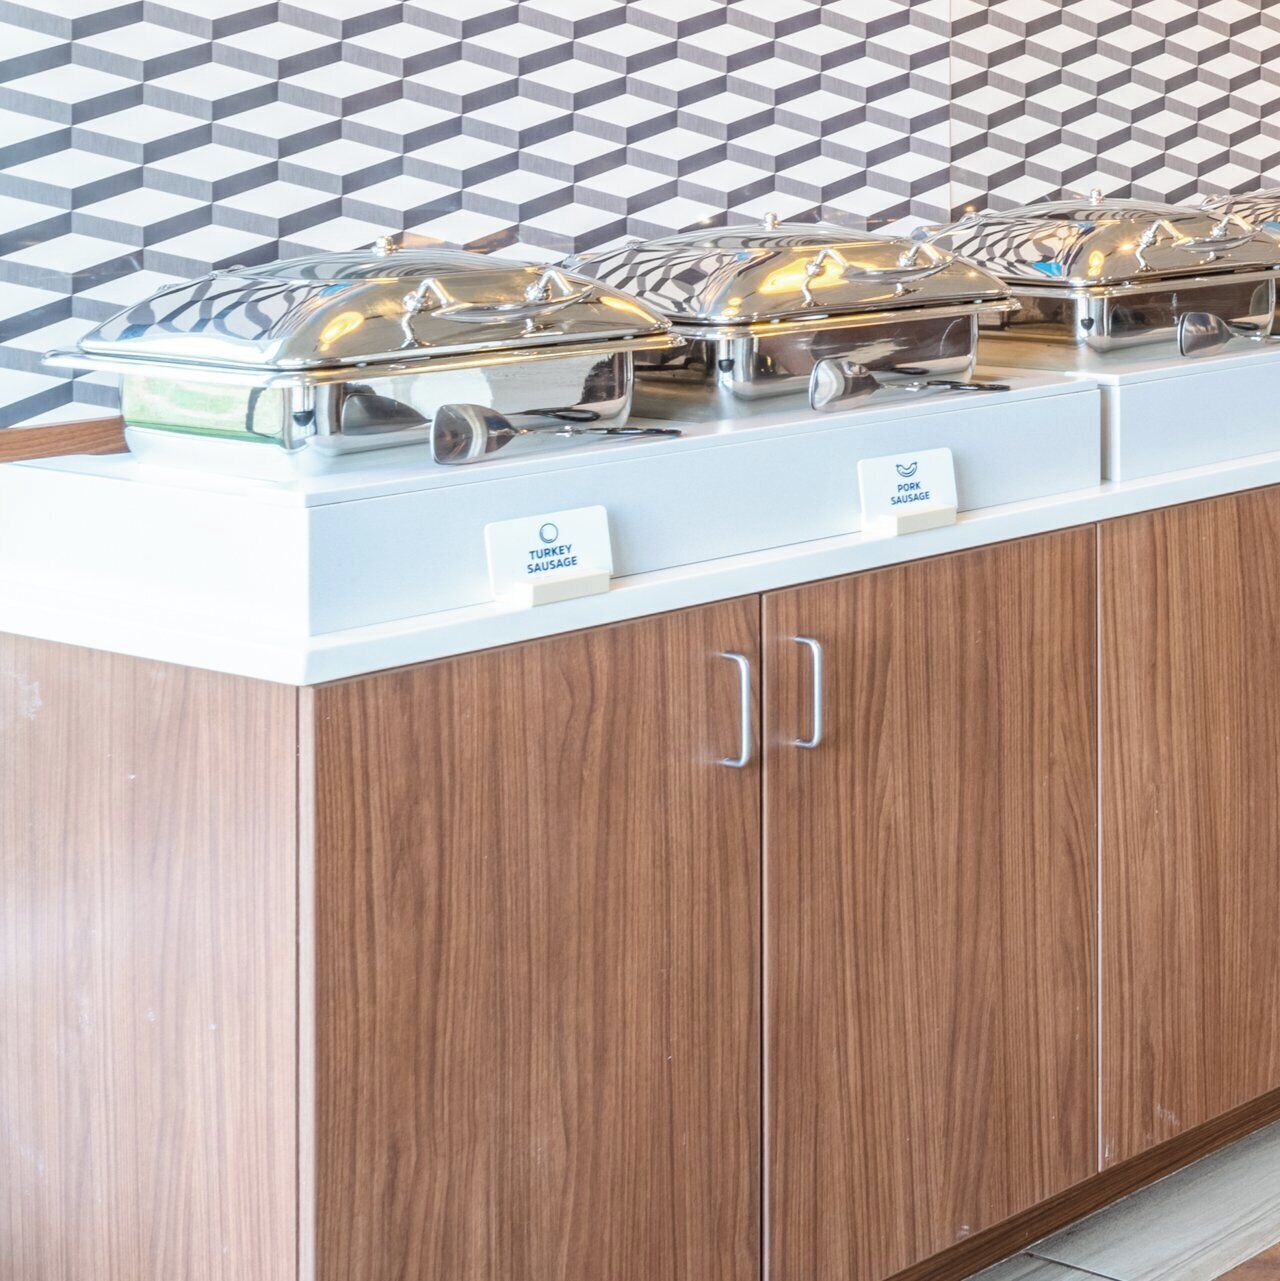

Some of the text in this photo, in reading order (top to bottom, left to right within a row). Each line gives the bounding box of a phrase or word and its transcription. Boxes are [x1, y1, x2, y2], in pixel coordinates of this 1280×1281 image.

[897, 481, 922, 494] PORK
[890, 491, 931, 506] SAUSAGE
[529, 543, 572, 560] TURKEY
[526, 555, 578, 575] SAUSAGE
